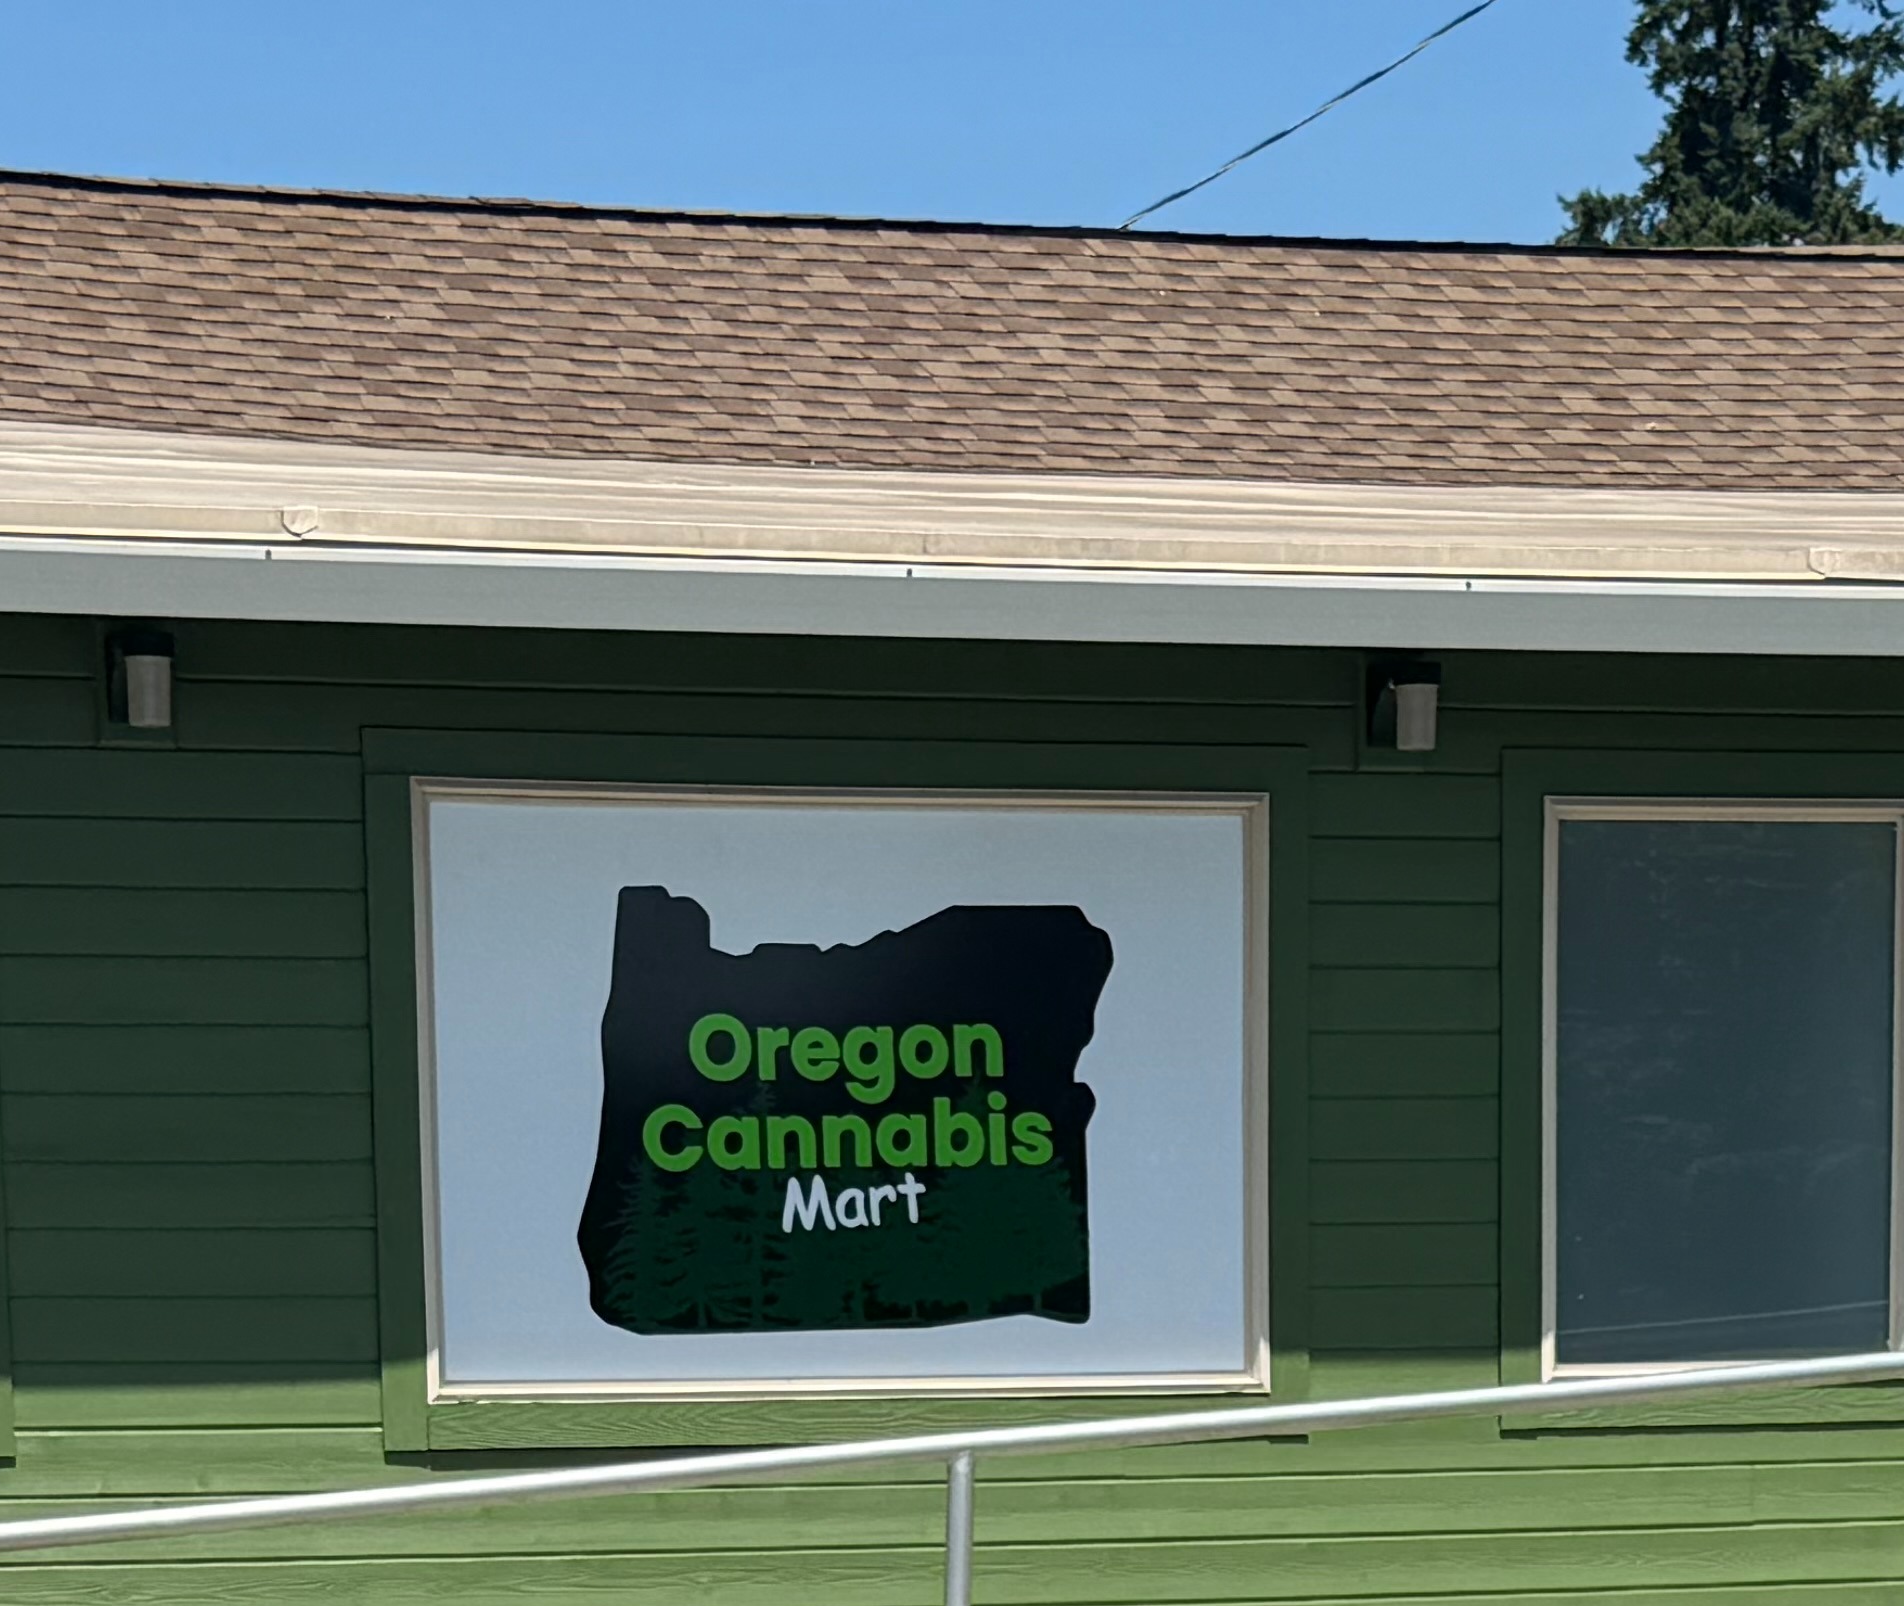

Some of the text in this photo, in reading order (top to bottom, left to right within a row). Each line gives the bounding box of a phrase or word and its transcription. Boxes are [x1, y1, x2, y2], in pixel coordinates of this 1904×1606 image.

[689, 1013, 1004, 1104] Oregon
[643, 1091, 1053, 1172] Cannabis
[781, 1172, 927, 1234] Mart
